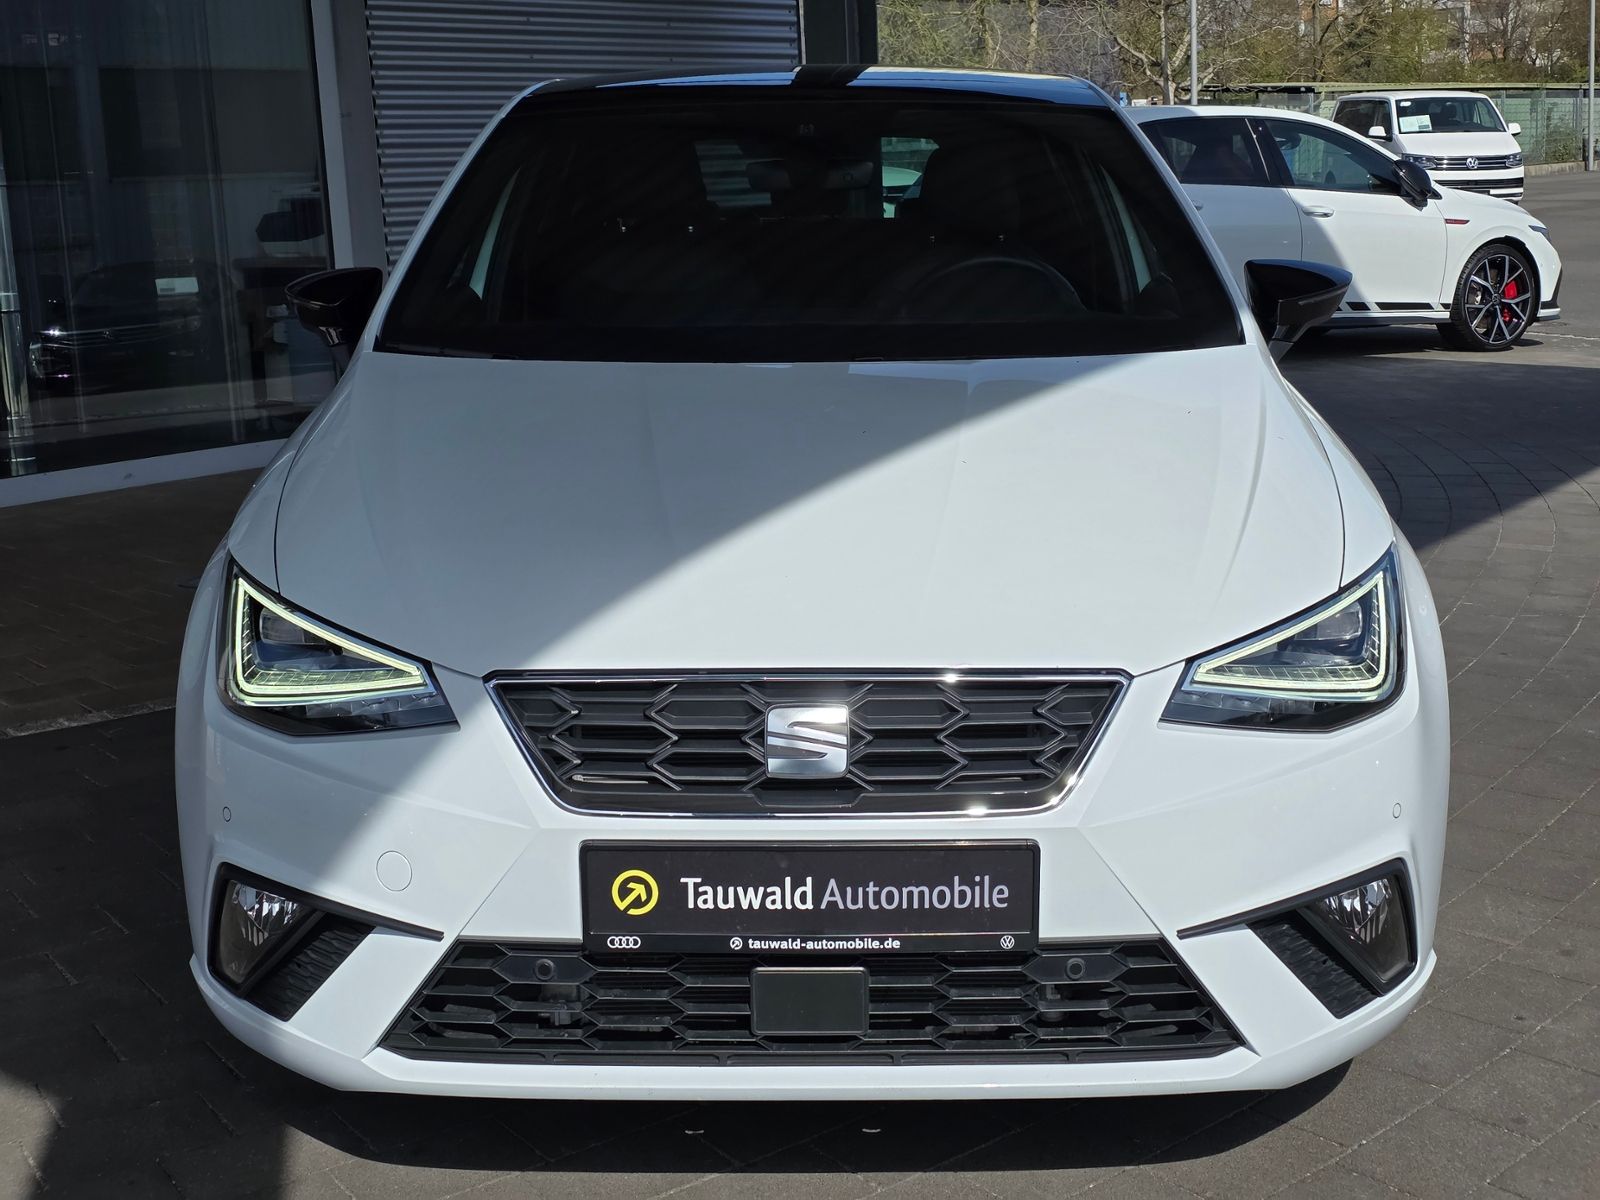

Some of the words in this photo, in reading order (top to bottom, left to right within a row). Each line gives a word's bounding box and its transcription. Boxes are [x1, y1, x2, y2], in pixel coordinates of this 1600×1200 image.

[679, 876, 814, 910] Tauwald
[820, 875, 1009, 910] Automobile
[748, 937, 901, 950] tauwald-automobile.de
